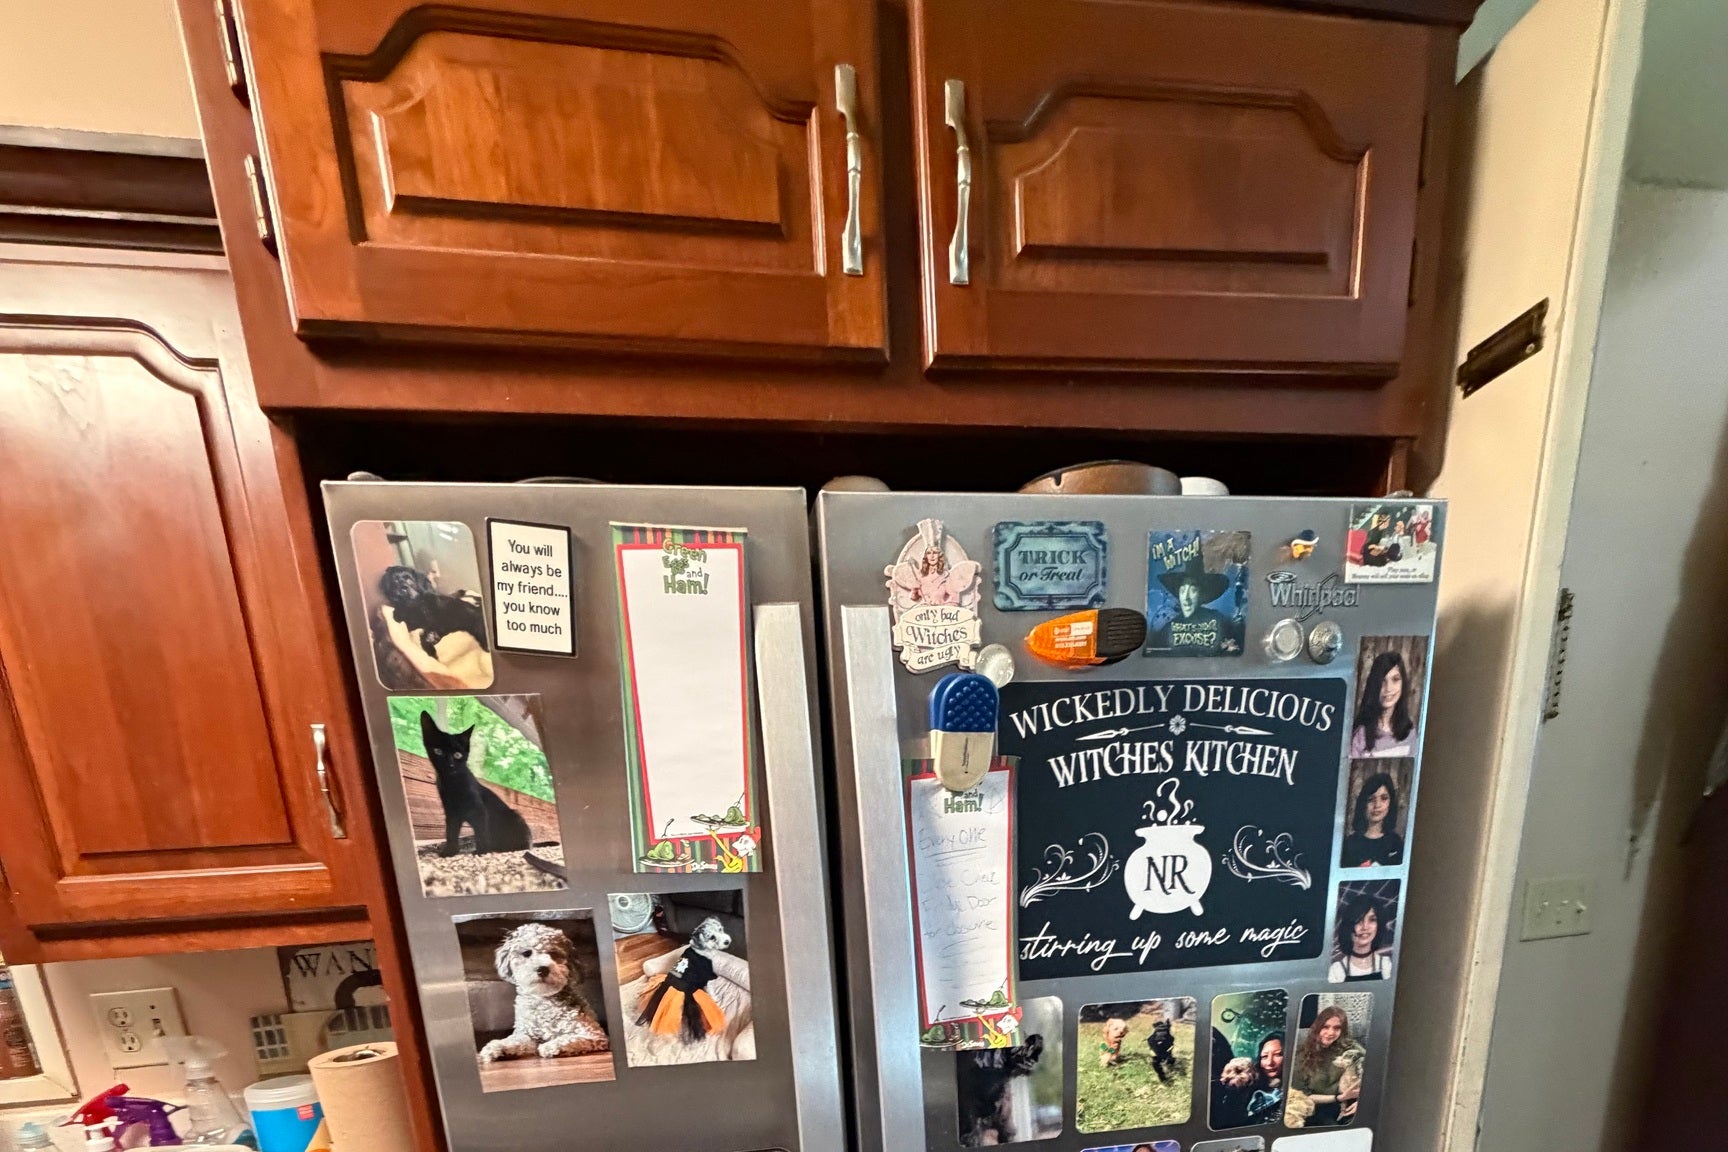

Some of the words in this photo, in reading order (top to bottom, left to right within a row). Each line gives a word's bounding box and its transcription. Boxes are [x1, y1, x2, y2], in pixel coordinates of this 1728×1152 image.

[508, 539, 530, 554] You
[533, 544, 553, 557] will
[663, 537, 707, 563] Green
[1018, 550, 1087, 565] TRICK
[501, 560, 543, 578] always
[546, 564, 562, 578] be
[686, 566, 703, 578] and
[1019, 571, 1037, 582] or
[1039, 566, 1083, 582] Treat
[497, 581, 514, 595] my
[663, 572, 710, 595] Ham!
[1269, 580, 1360, 614] Whirlpool
[503, 601, 525, 614] you
[528, 602, 561, 616] know
[915, 608, 938, 623] only
[940, 608, 960, 622] bad
[506, 619, 527, 632] too
[529, 623, 562, 635] much
[905, 625, 968, 645] Witches
[1172, 631, 1217, 648] EXCUSE?
[917, 653, 934, 664] are
[937, 645, 961, 660] ugly
[1009, 684, 1175, 739] WICKEDLY
[1184, 684, 1336, 732] DELICIOUS
[1048, 740, 1175, 788] WITCHES
[1184, 740, 1299, 786] KITCHEN
[944, 793, 984, 814] Ham!
[1143, 854, 1196, 895] NR
[1019, 921, 1134, 971] stirring
[1131, 931, 1162, 965] up
[1175, 925, 1231, 949] some
[1240, 918, 1309, 958] magic
